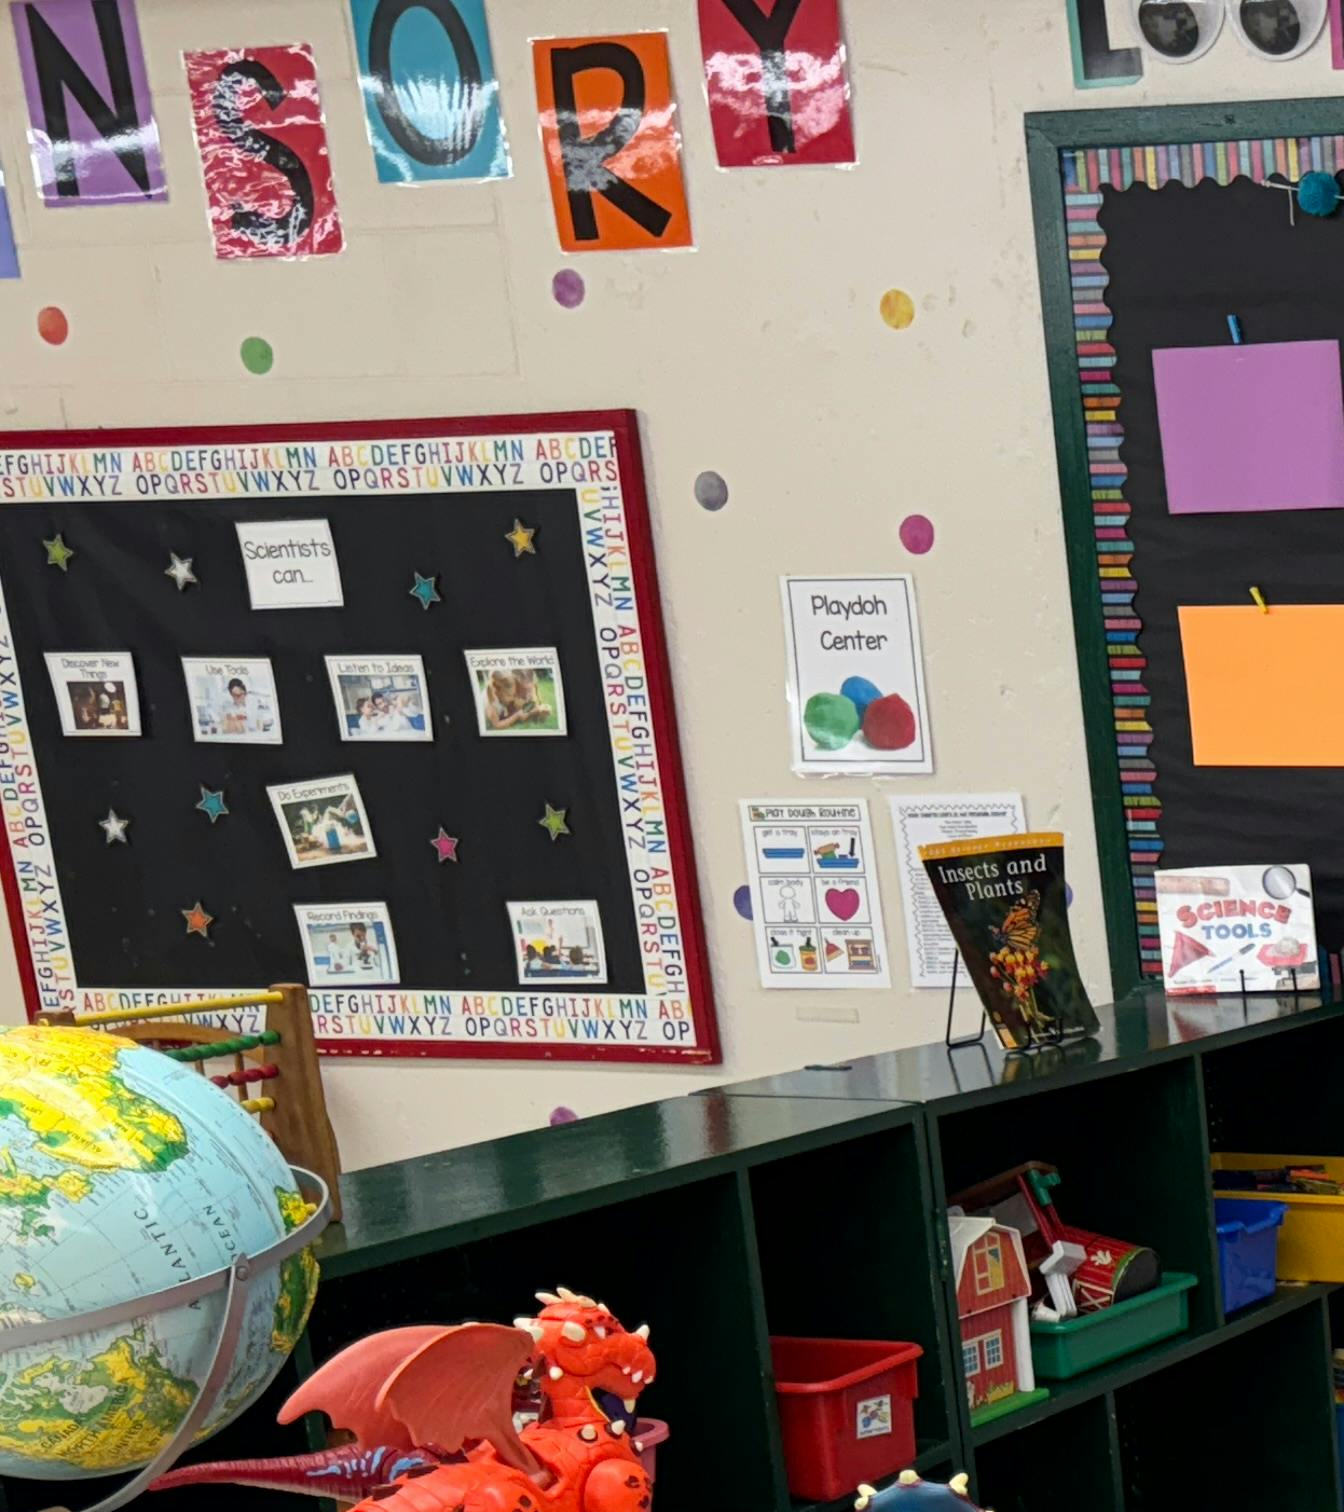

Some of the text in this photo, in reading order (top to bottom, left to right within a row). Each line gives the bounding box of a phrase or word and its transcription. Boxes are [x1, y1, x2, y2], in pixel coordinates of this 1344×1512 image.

[132, 446, 317, 473] ABCDEFGHIJKLMN
[328, 438, 524, 468] ABCDEFGHIJKLMN
[136, 470, 320, 495] OPQRSTUVWXYZ
[333, 463, 524, 490] OPQRSTUVWXYZ
[243, 539, 331, 560] Scientists
[811, 594, 888, 621] Playdoh
[820, 629, 888, 651] Center
[508, 656, 526, 666] the
[937, 853, 1047, 884] Insects and
[965, 879, 1024, 901] Plants
[1176, 899, 1293, 928] SCIENCE
[1201, 922, 1273, 940] TOOLS
[466, 1017, 648, 1041] OPQRSTUVWXYZ
[663, 1021, 691, 1041] OP
[135, 1207, 201, 1310] ALANTIC
